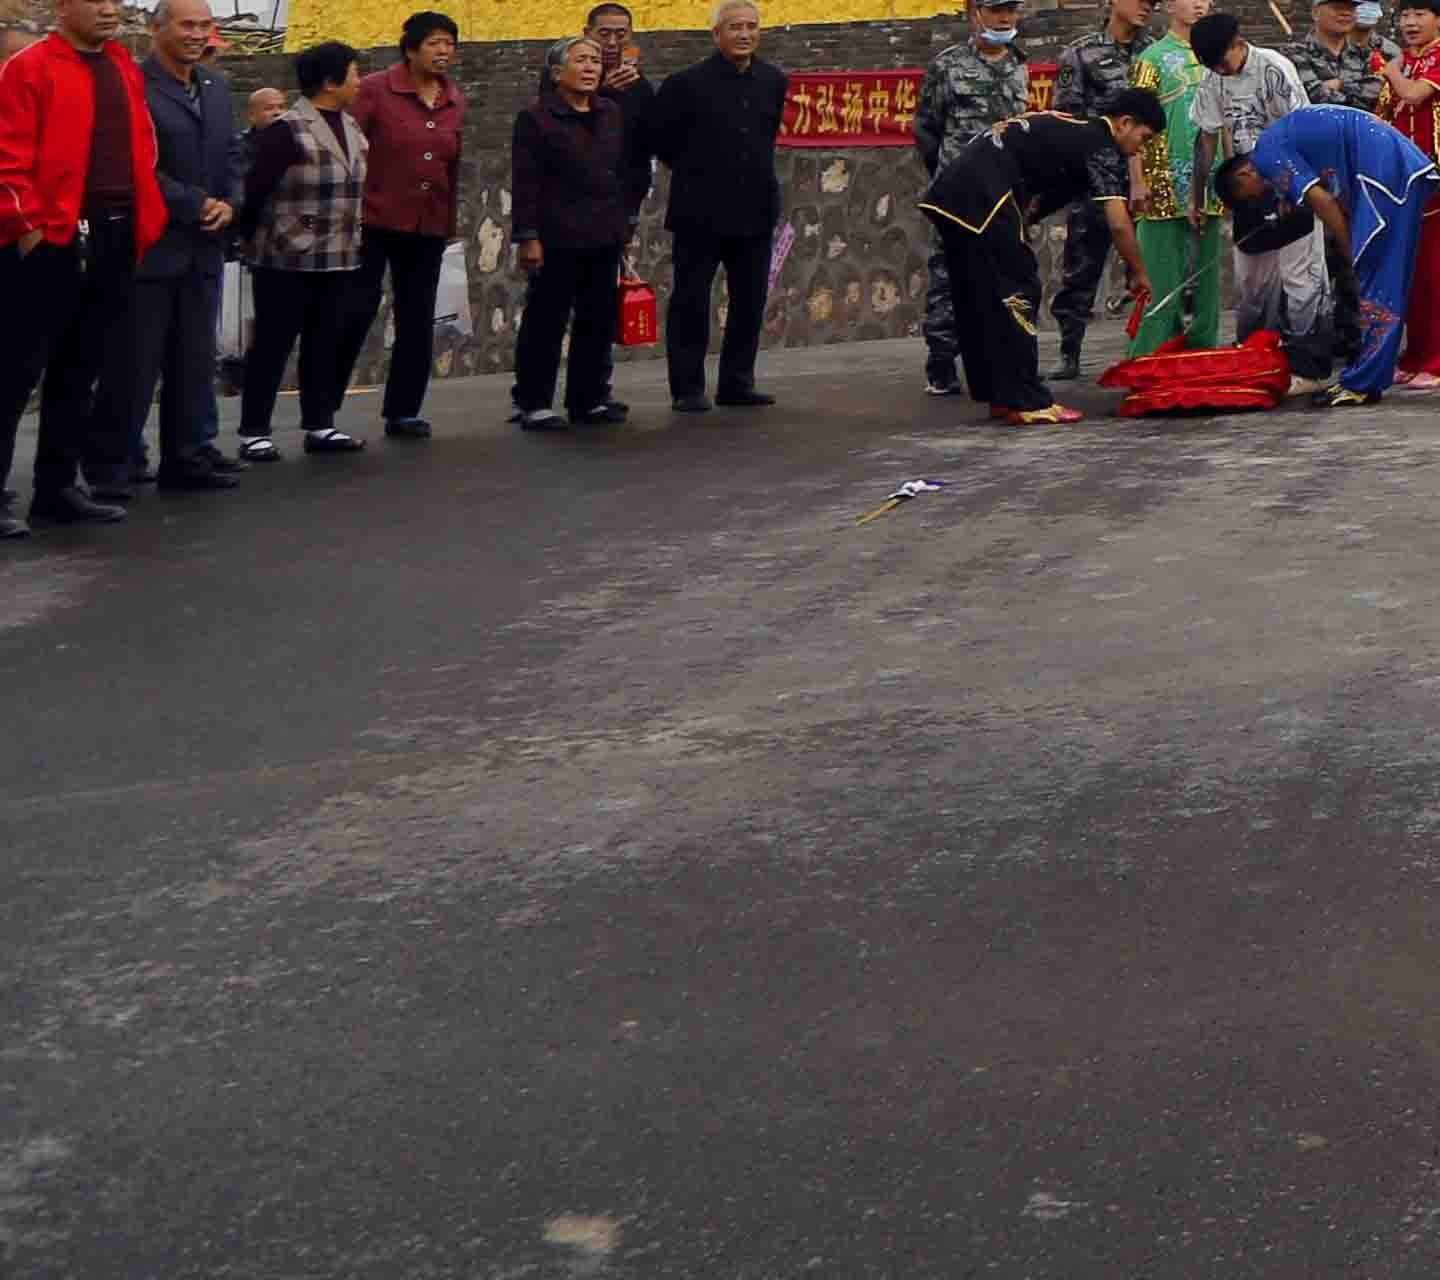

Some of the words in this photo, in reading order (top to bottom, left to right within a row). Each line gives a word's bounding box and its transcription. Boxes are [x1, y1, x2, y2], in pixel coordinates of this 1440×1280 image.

[779, 78, 917, 136] 力弘扬中华
